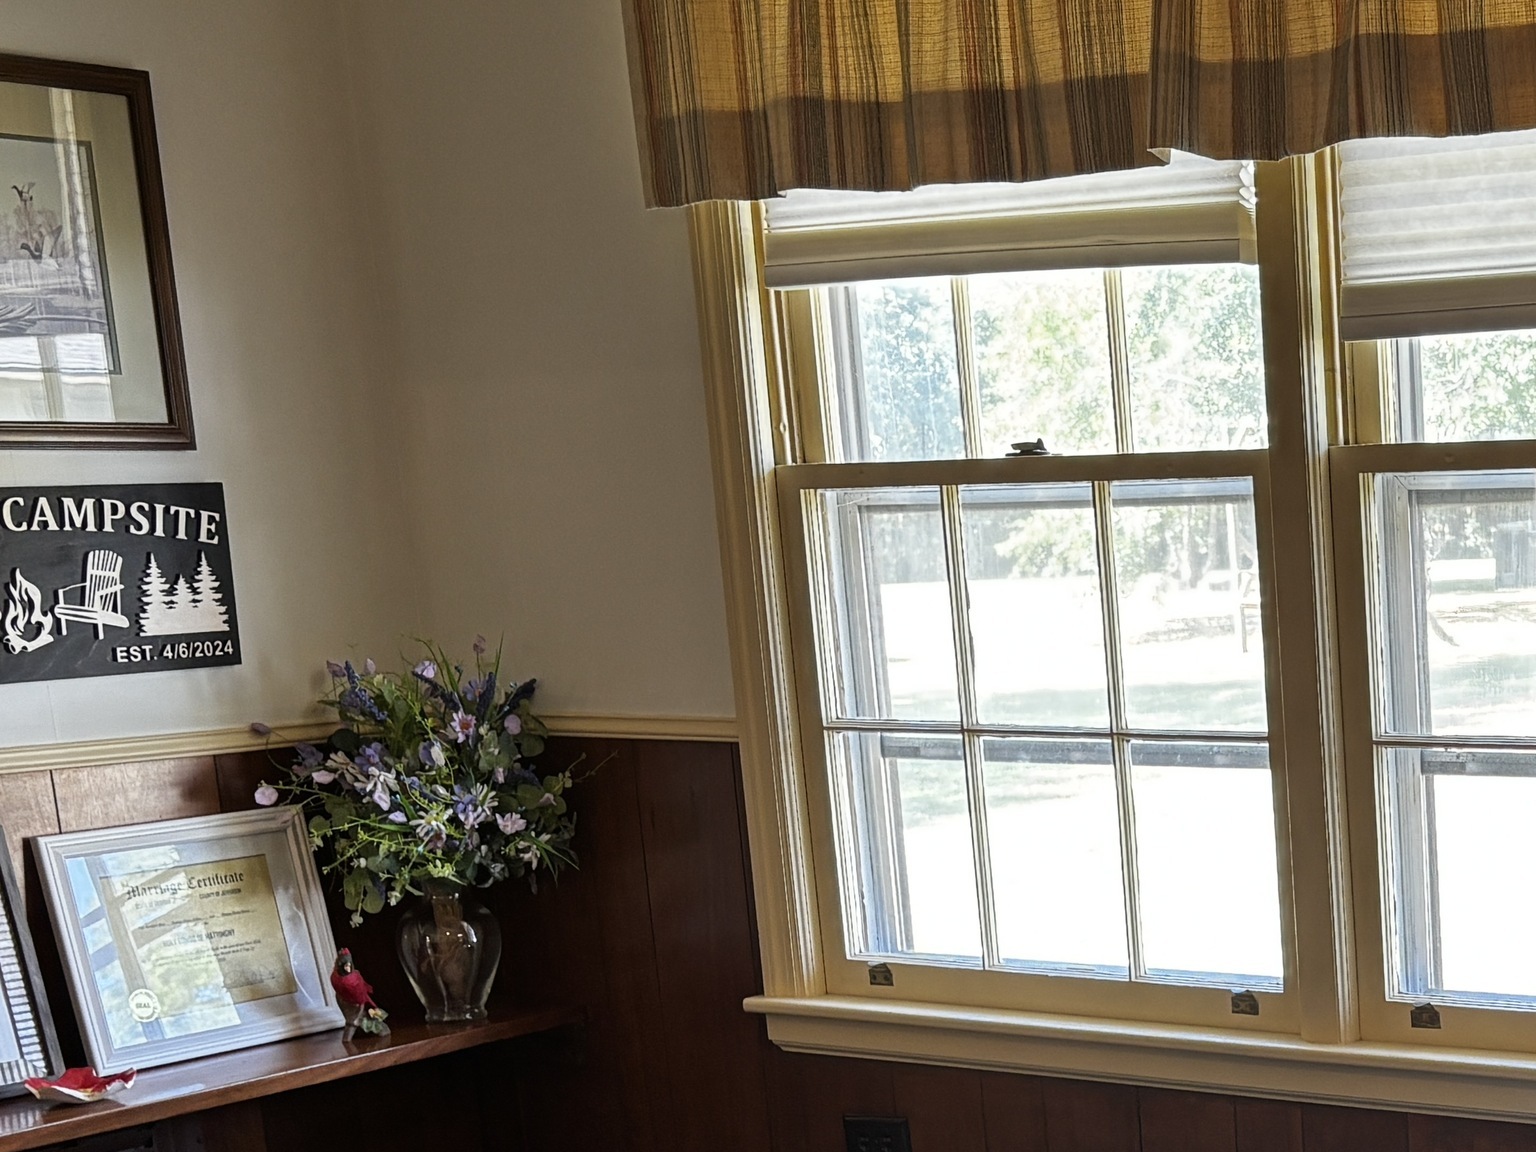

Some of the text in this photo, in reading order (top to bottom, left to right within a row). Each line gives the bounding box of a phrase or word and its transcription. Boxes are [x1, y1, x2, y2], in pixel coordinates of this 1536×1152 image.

[2, 497, 220, 544] CAMPSITE
[116, 640, 233, 663] EST. 4/6/2024
[126, 872, 244, 900] Marriage Certificate
